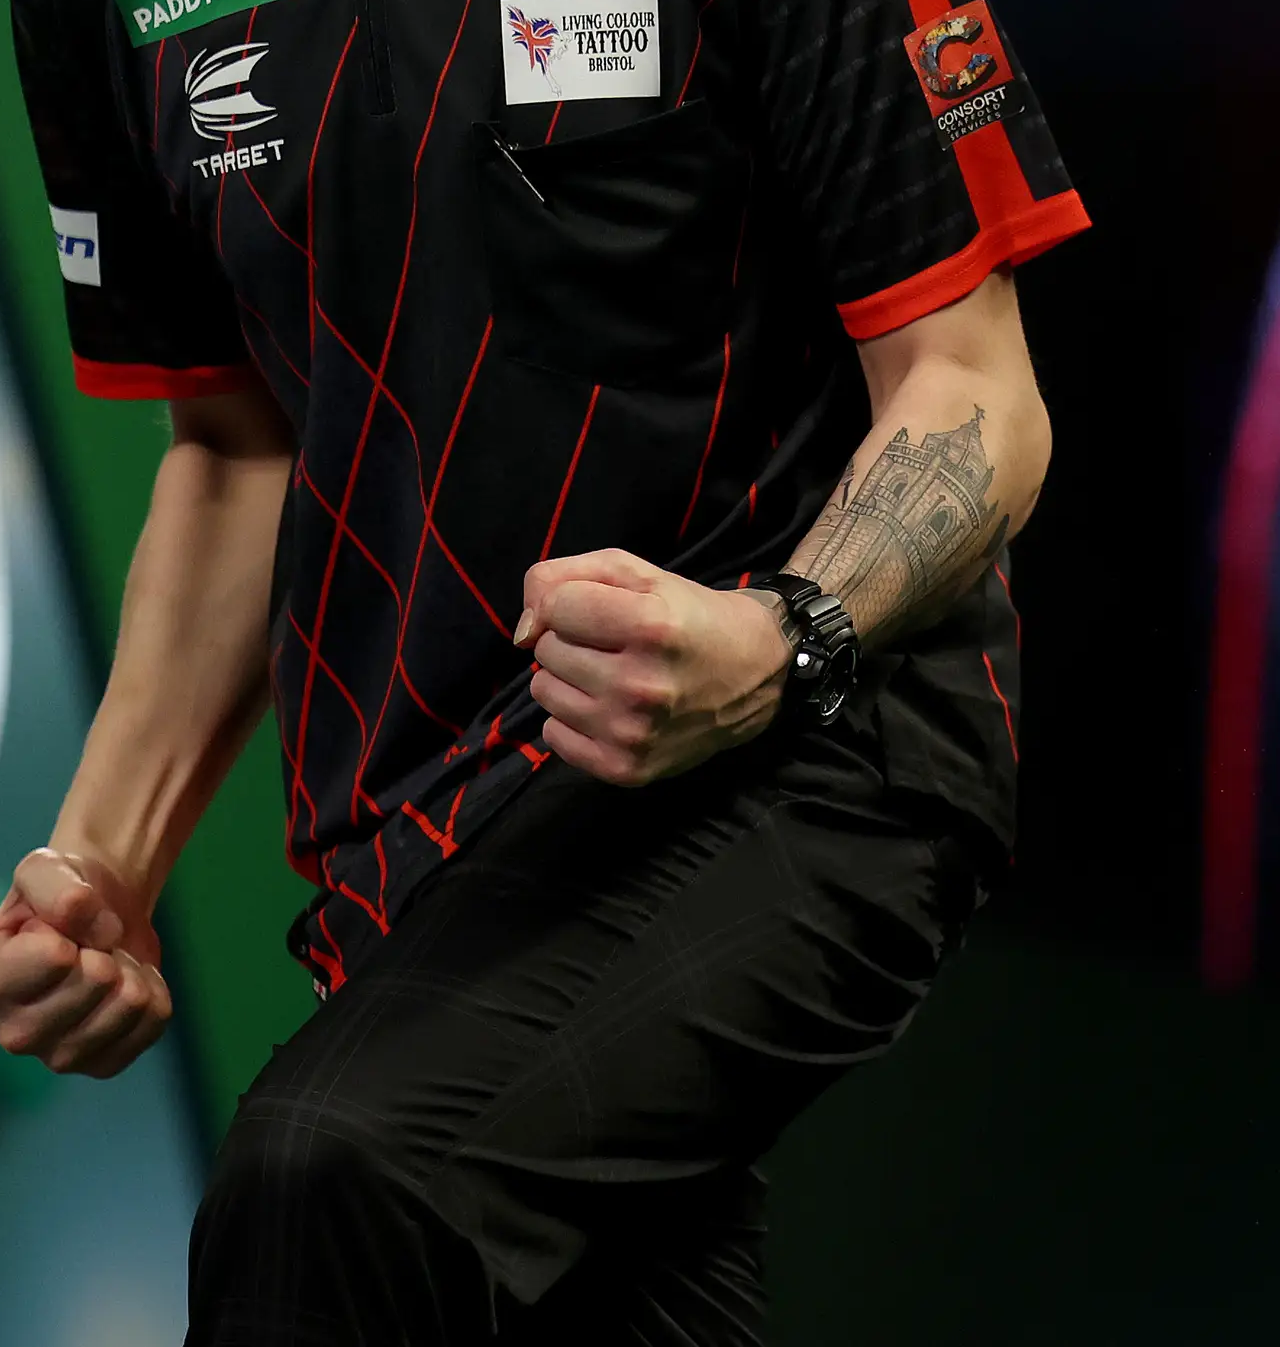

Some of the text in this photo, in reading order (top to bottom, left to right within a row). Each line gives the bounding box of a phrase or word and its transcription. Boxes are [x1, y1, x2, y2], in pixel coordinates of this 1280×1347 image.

[562, 11, 656, 32] LIVING COLOUR
[574, 28, 649, 55] TATTOO
[588, 55, 636, 73] BRISTOL
[937, 84, 1007, 131] CONSORT
[945, 102, 1002, 134] SCAFFOLD
[949, 111, 1002, 142] SERVICES
[192, 138, 285, 179] TARGET
